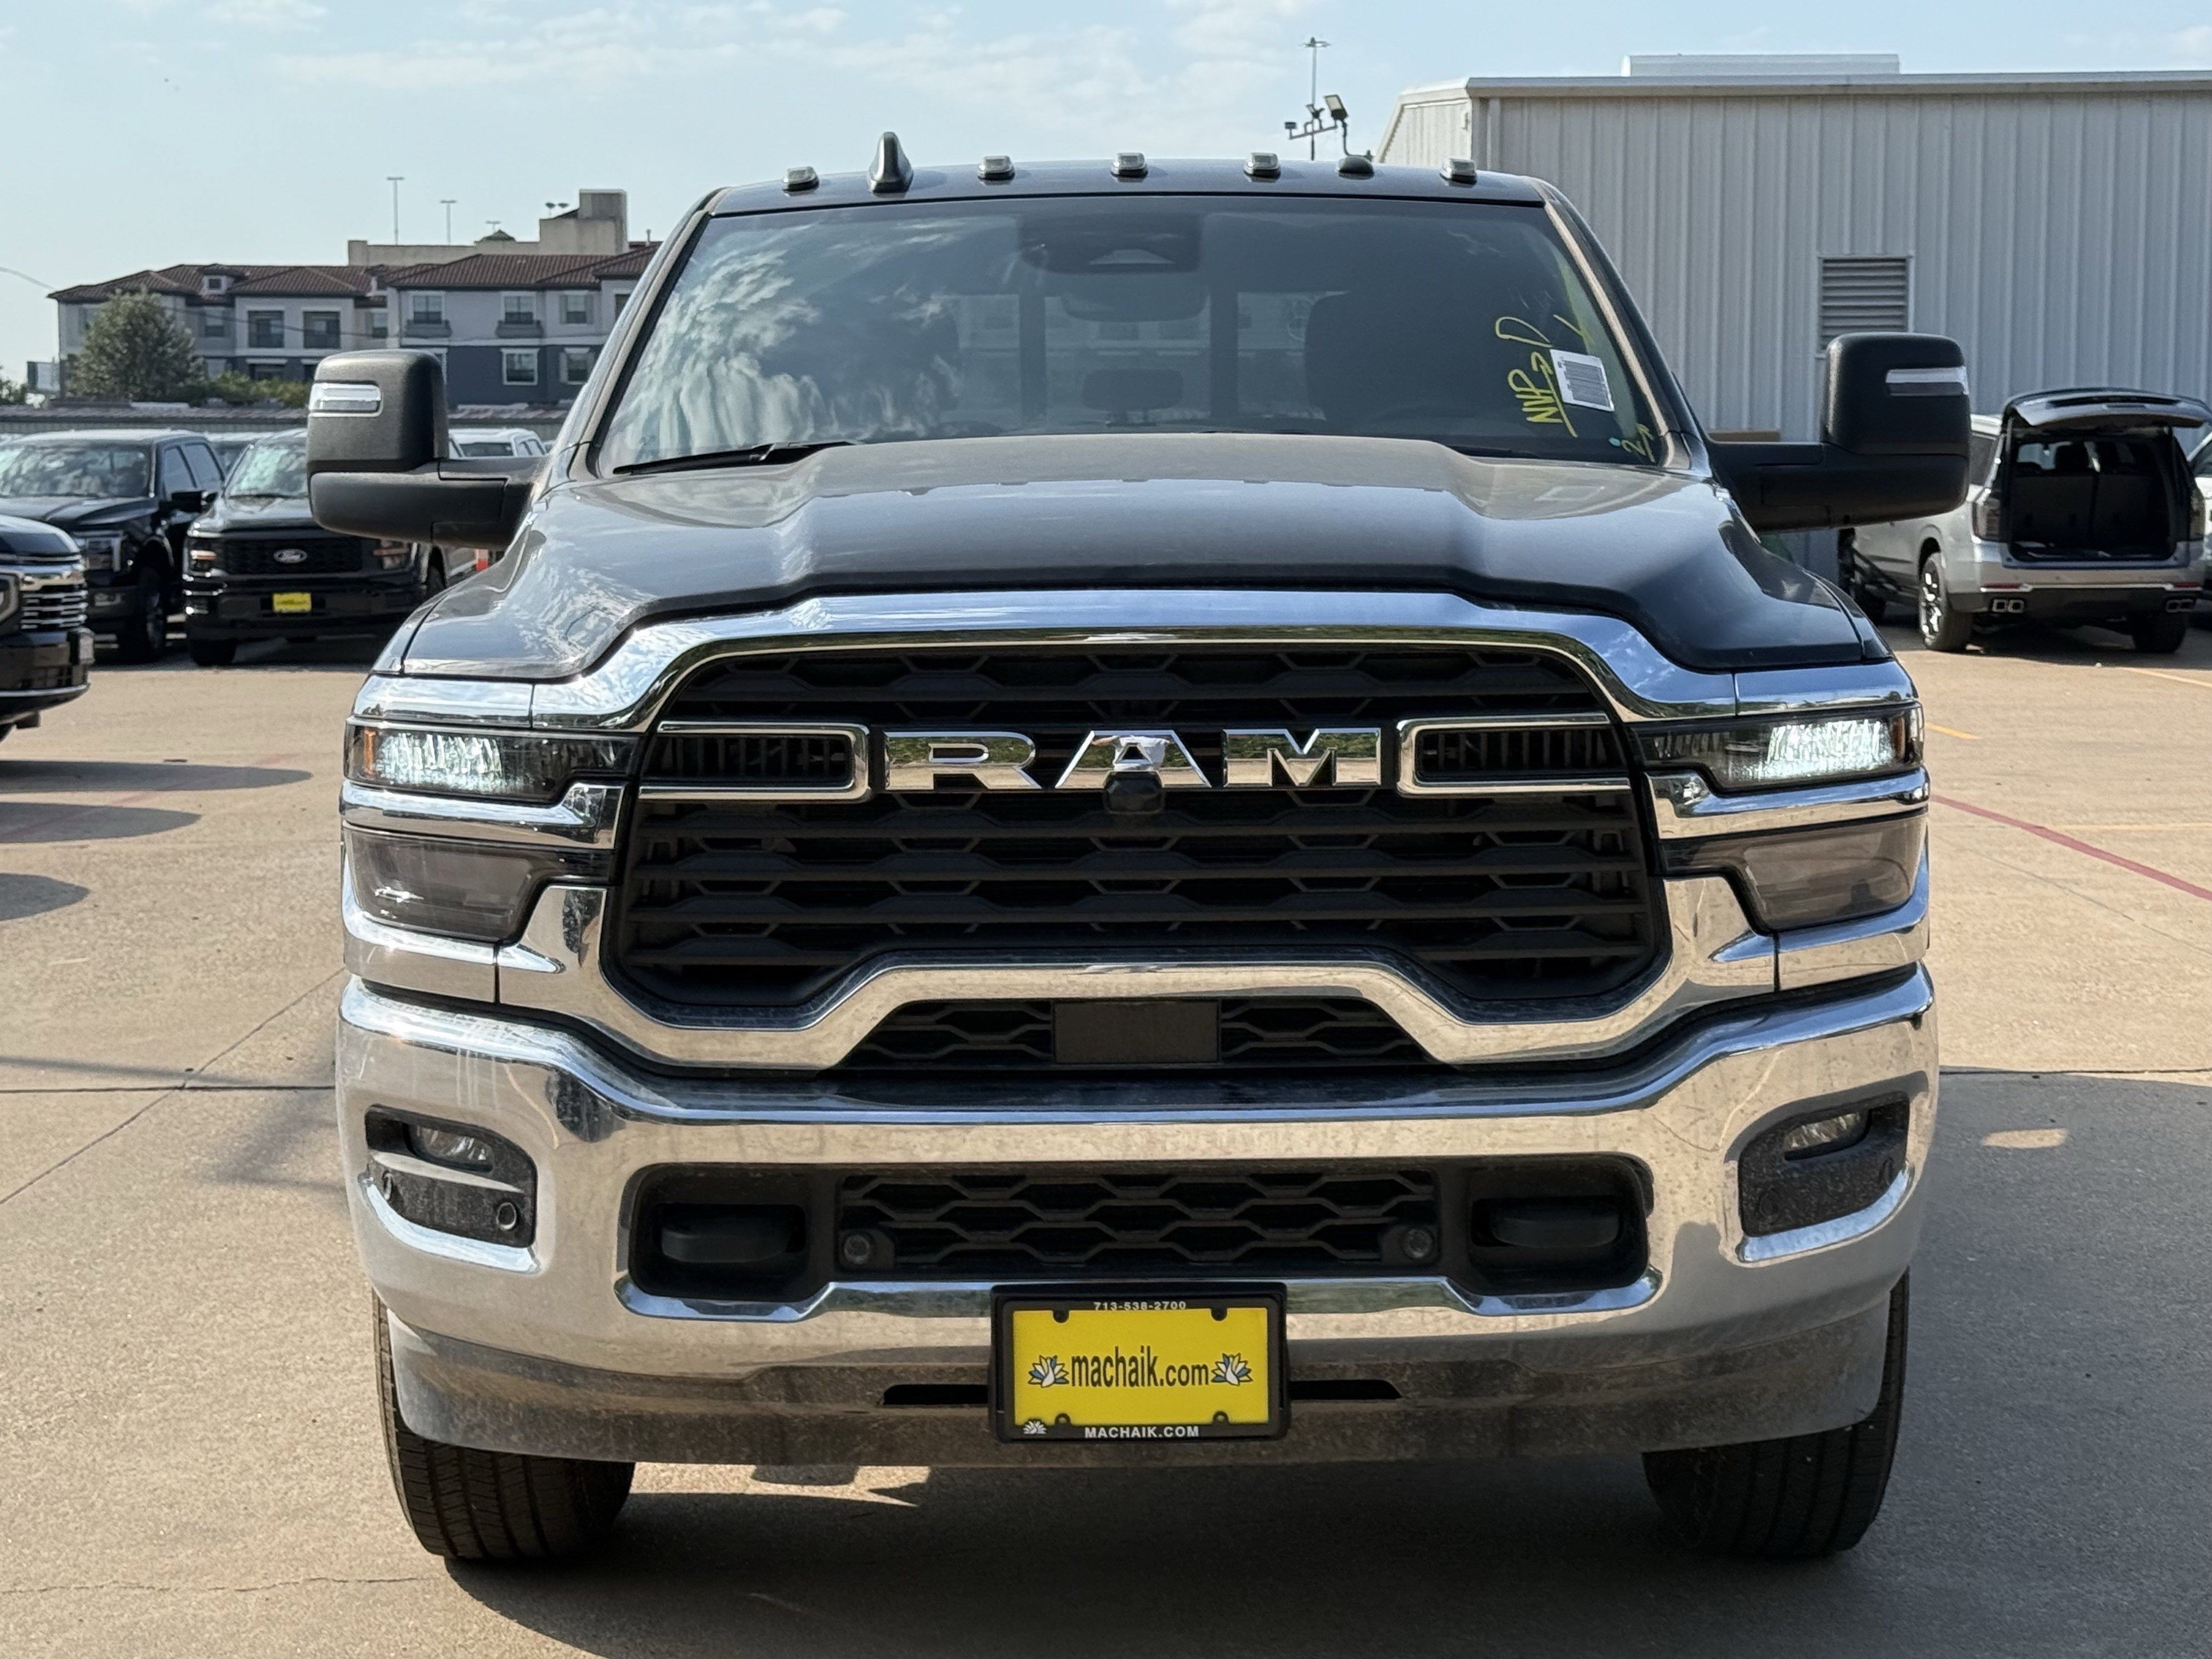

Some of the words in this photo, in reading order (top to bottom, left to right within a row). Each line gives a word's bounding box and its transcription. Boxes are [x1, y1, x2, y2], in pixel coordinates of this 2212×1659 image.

[885, 729, 1381, 788] RAM
[1093, 1301, 1186, 1311] 713-538-2700
[1071, 1345, 1209, 1386] machaik.com
[1085, 1426, 1199, 1438] MACHAIK.COM
